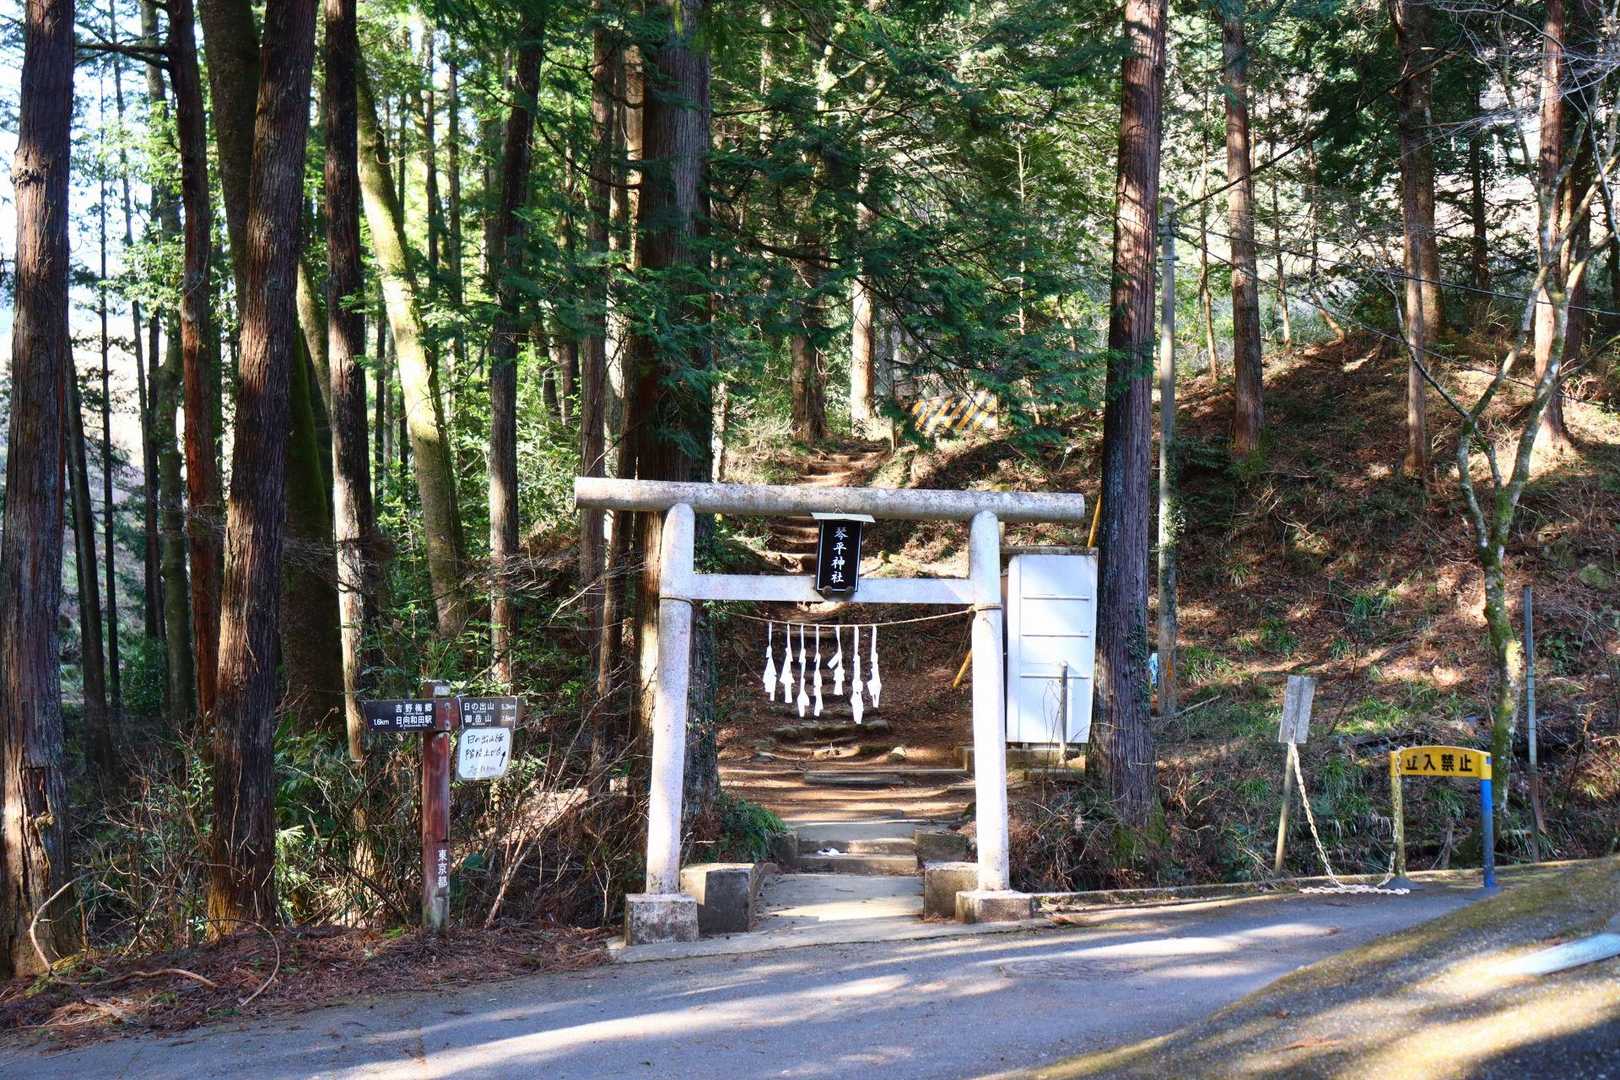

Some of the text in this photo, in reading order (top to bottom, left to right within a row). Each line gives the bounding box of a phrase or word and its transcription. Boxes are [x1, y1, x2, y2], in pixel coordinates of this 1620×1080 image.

[831, 527, 848, 584] 琴平神社
[395, 703, 433, 713] 吉野梅郷
[464, 702, 495, 711] 日の出山
[396, 715, 433, 725] 日向和田駅
[1405, 753, 1473, 772] 立入禁止
[437, 848, 448, 889] 東京都
